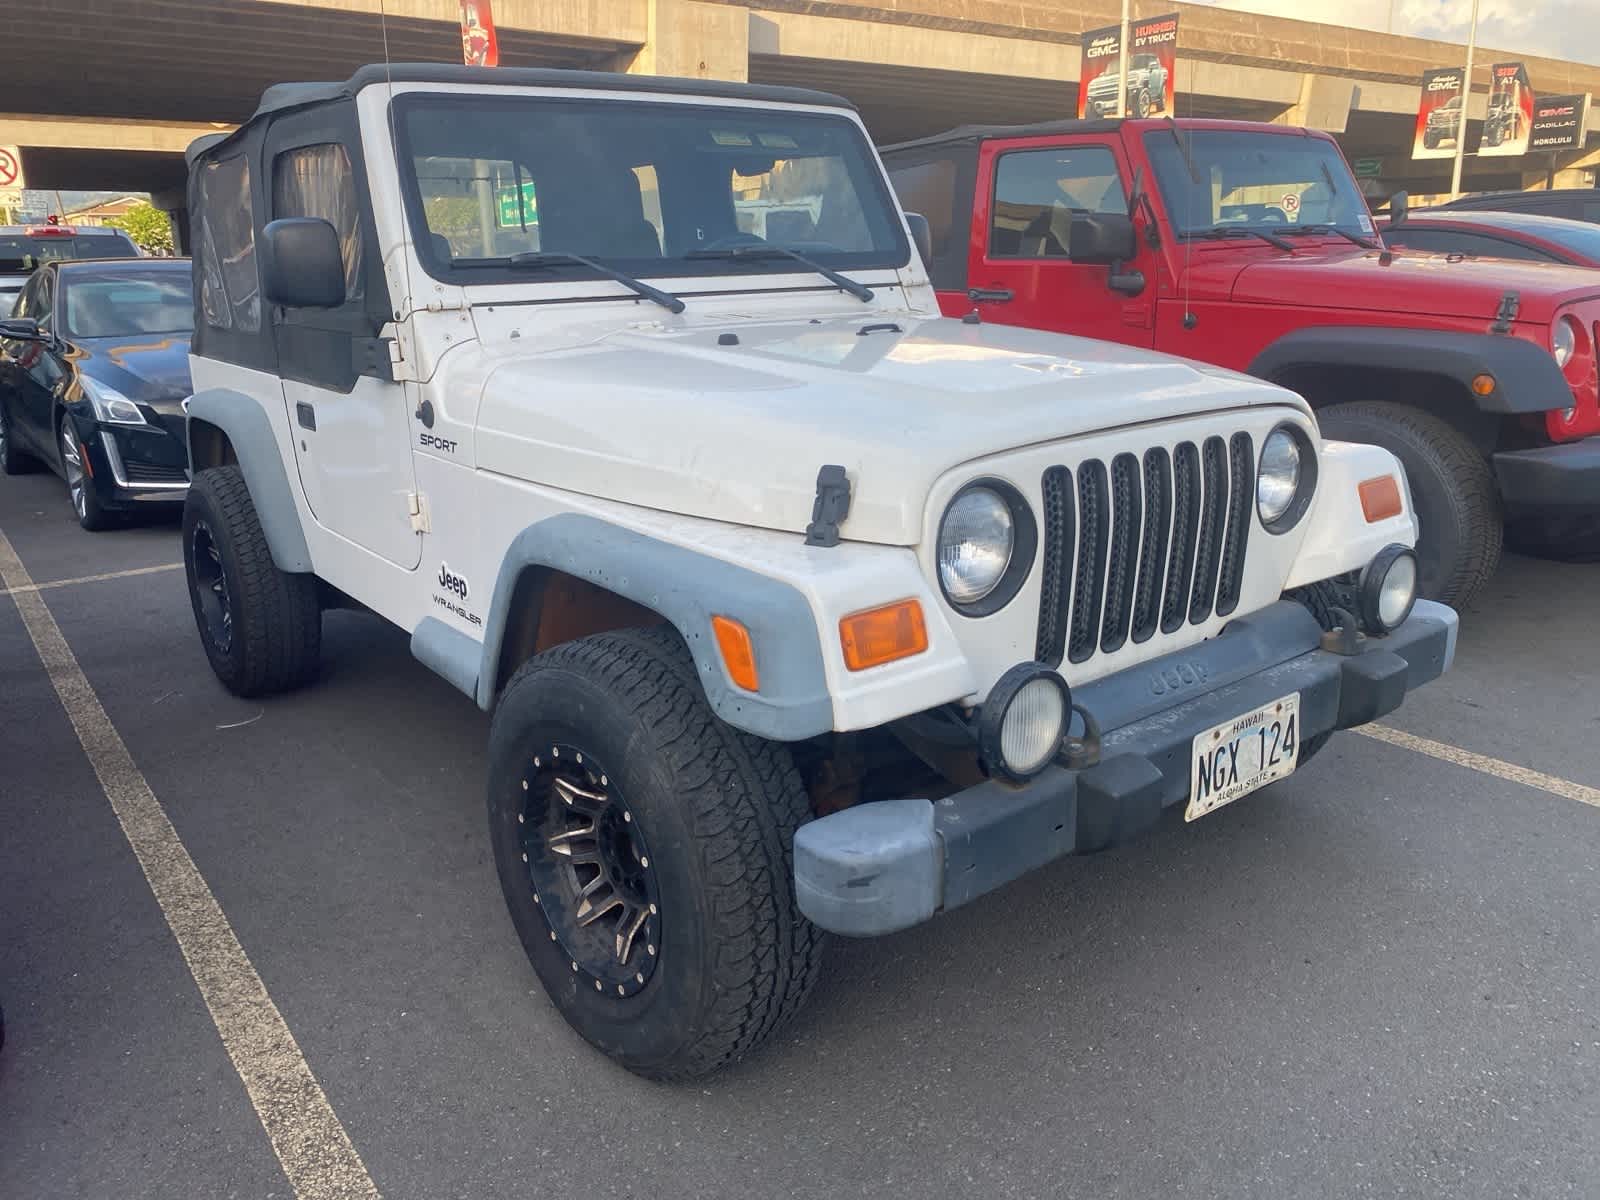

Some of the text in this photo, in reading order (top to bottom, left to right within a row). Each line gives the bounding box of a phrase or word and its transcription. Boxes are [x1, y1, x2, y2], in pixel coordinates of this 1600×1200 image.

[1135, 21, 1177, 37] HUMMER
[1135, 31, 1176, 47] EV TRUCK
[1087, 43, 1120, 58] GMC
[1427, 80, 1461, 91] GMC
[1538, 107, 1574, 118] GMC
[1534, 121, 1576, 129] CADILLAC
[1534, 136, 1572, 145] HONOLULU
[420, 433, 458, 453] SPORT
[438, 565, 468, 600] Jeep
[432, 593, 482, 627] WRANGLER
[1232, 711, 1264, 734] HAWAII
[1197, 712, 1295, 802] NGX 124
[1217, 770, 1270, 801] ALOHA STATE
